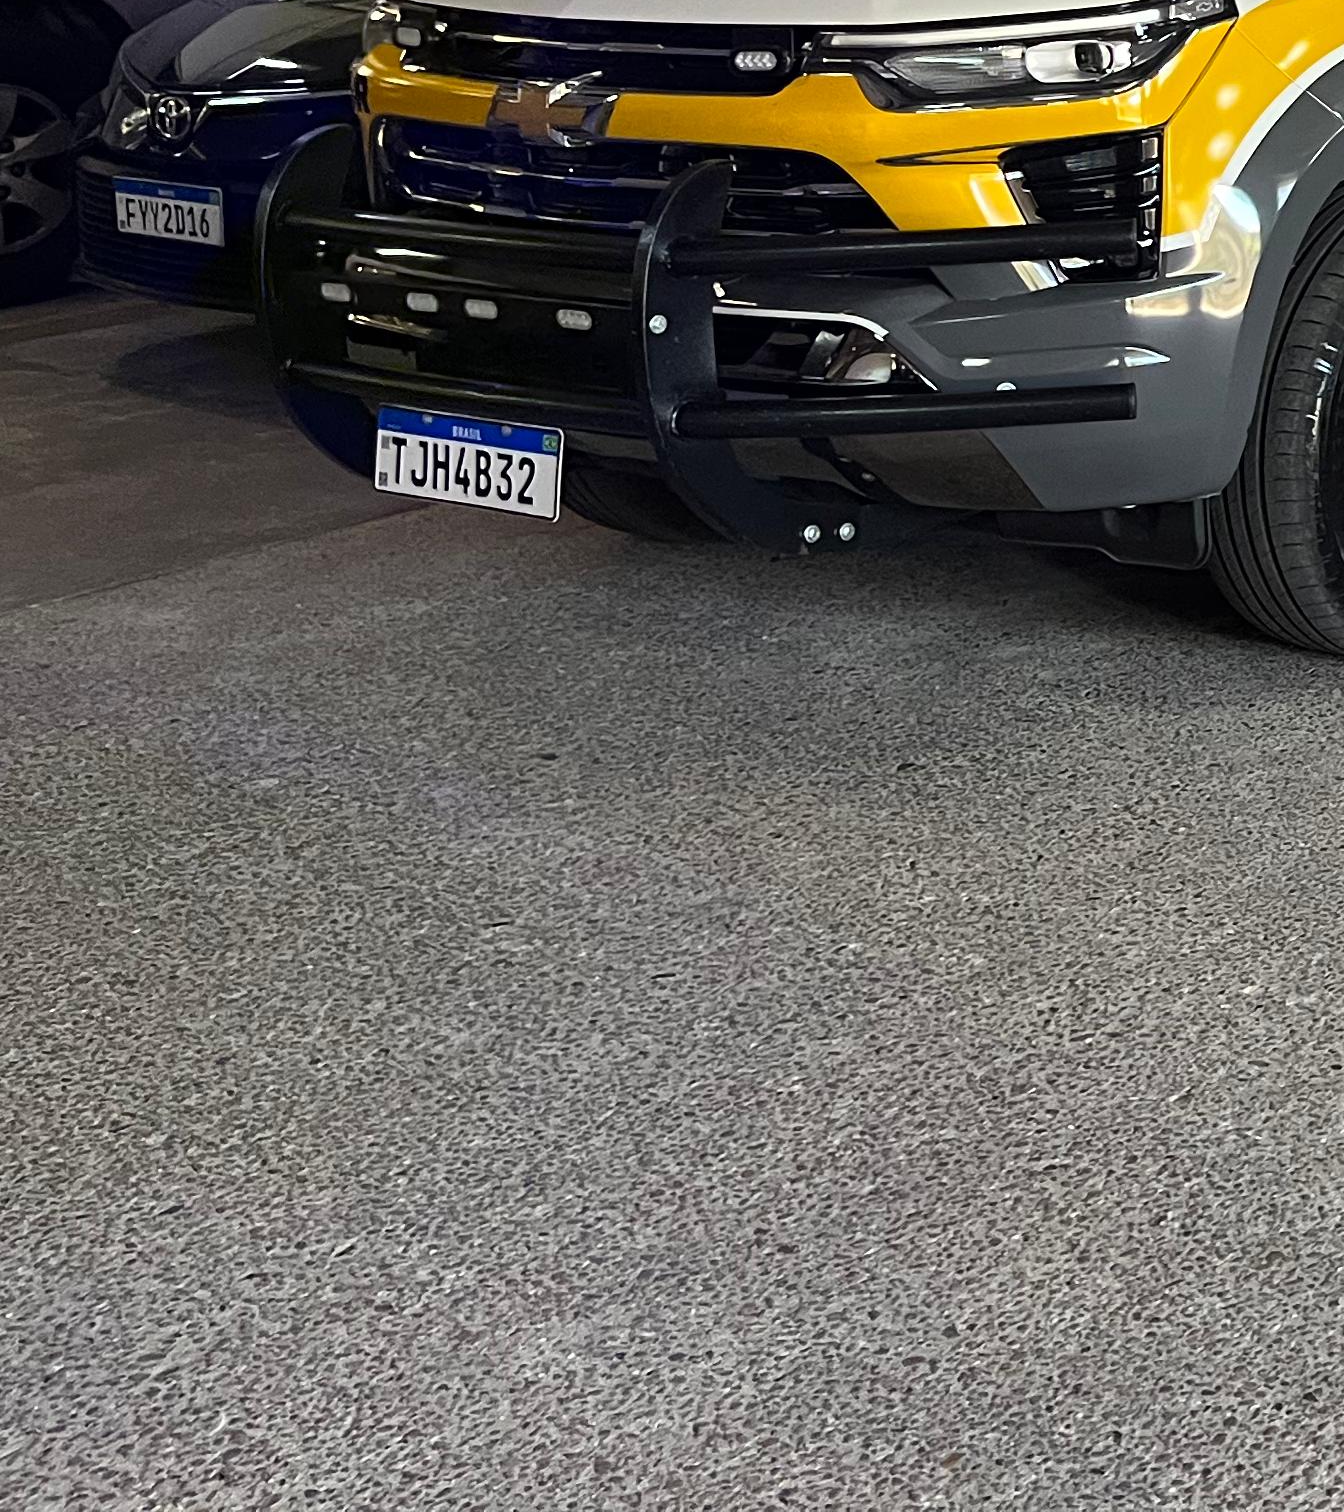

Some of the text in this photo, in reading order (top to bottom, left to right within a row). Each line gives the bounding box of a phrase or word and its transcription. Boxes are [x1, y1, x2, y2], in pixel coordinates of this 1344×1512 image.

[126, 197, 210, 238] FYY2D16
[452, 425, 482, 441] BRASIL
[391, 436, 536, 506] TJH4B32
